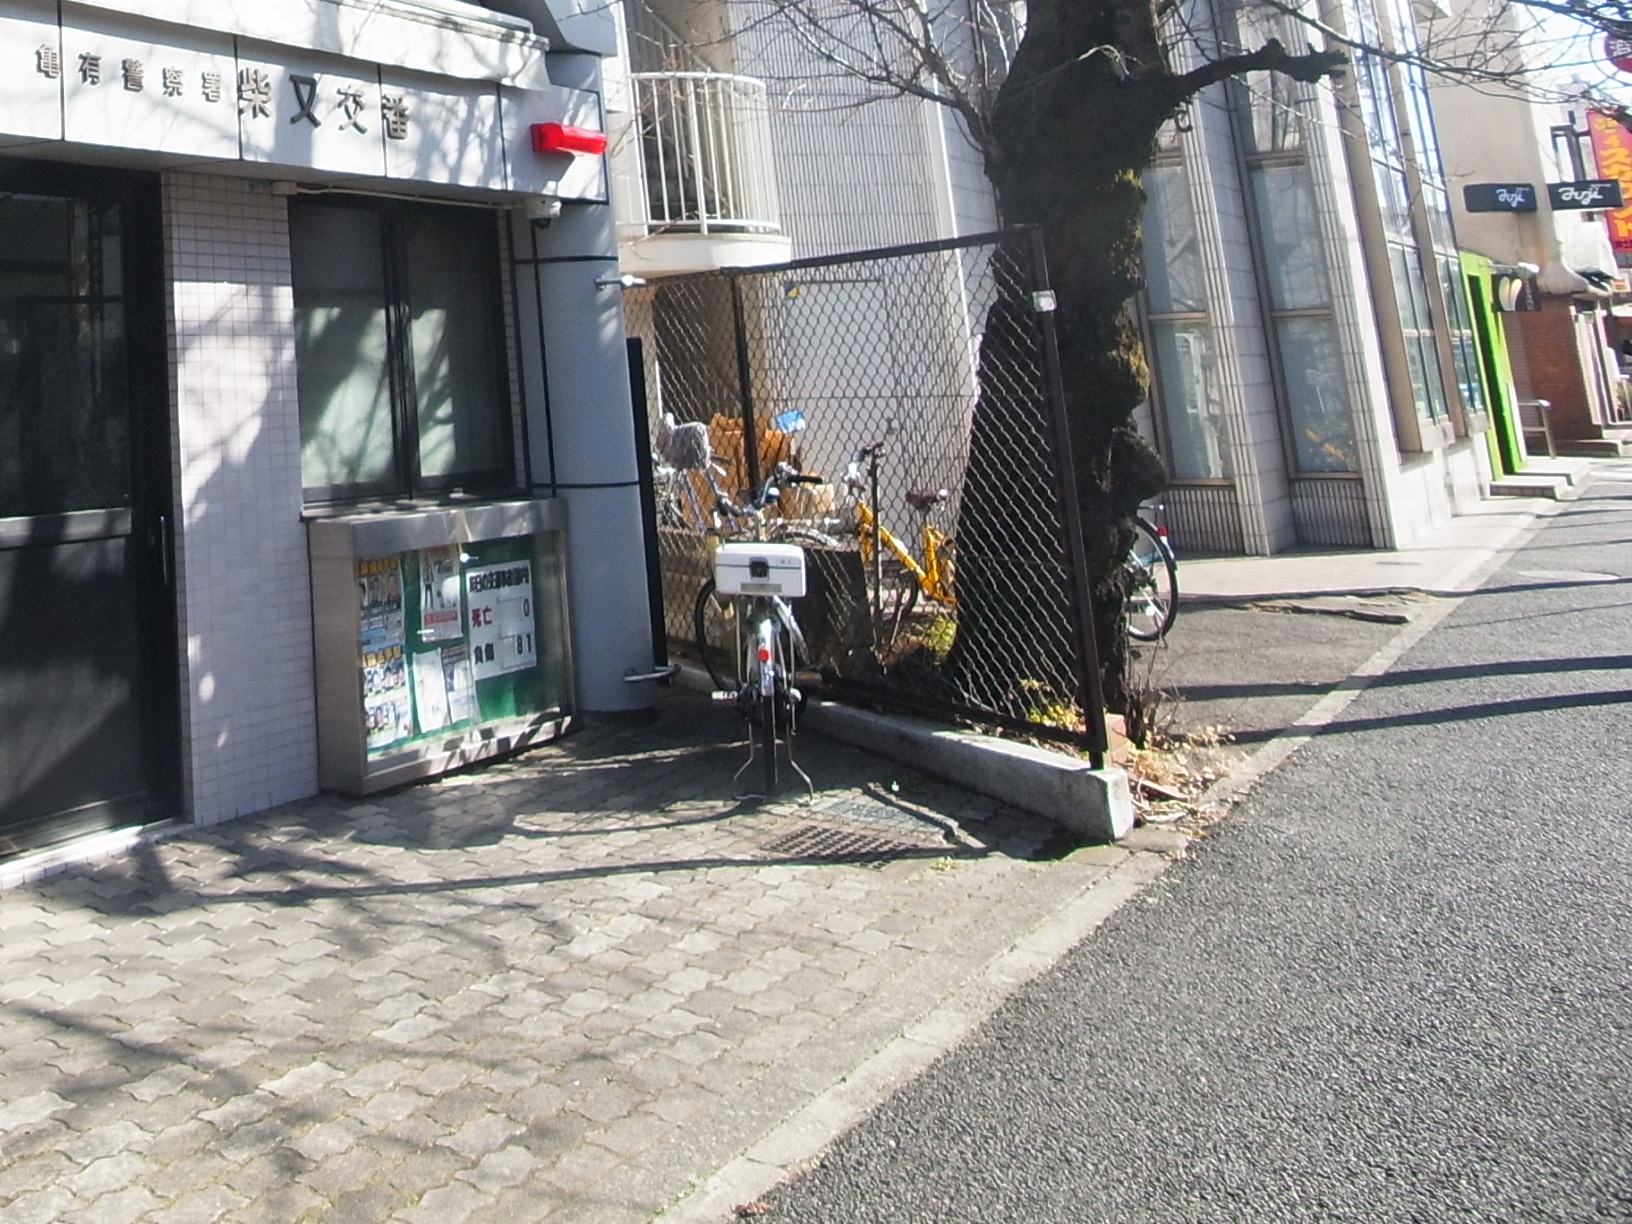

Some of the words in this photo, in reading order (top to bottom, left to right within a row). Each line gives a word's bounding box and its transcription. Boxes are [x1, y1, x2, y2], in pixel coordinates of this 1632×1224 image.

[34, 43, 223, 103] 亀有警察署
[237, 67, 411, 140] 柴又交番
[471, 605, 493, 628] 死亡
[523, 598, 530, 617] 0
[516, 633, 532, 655] 81
